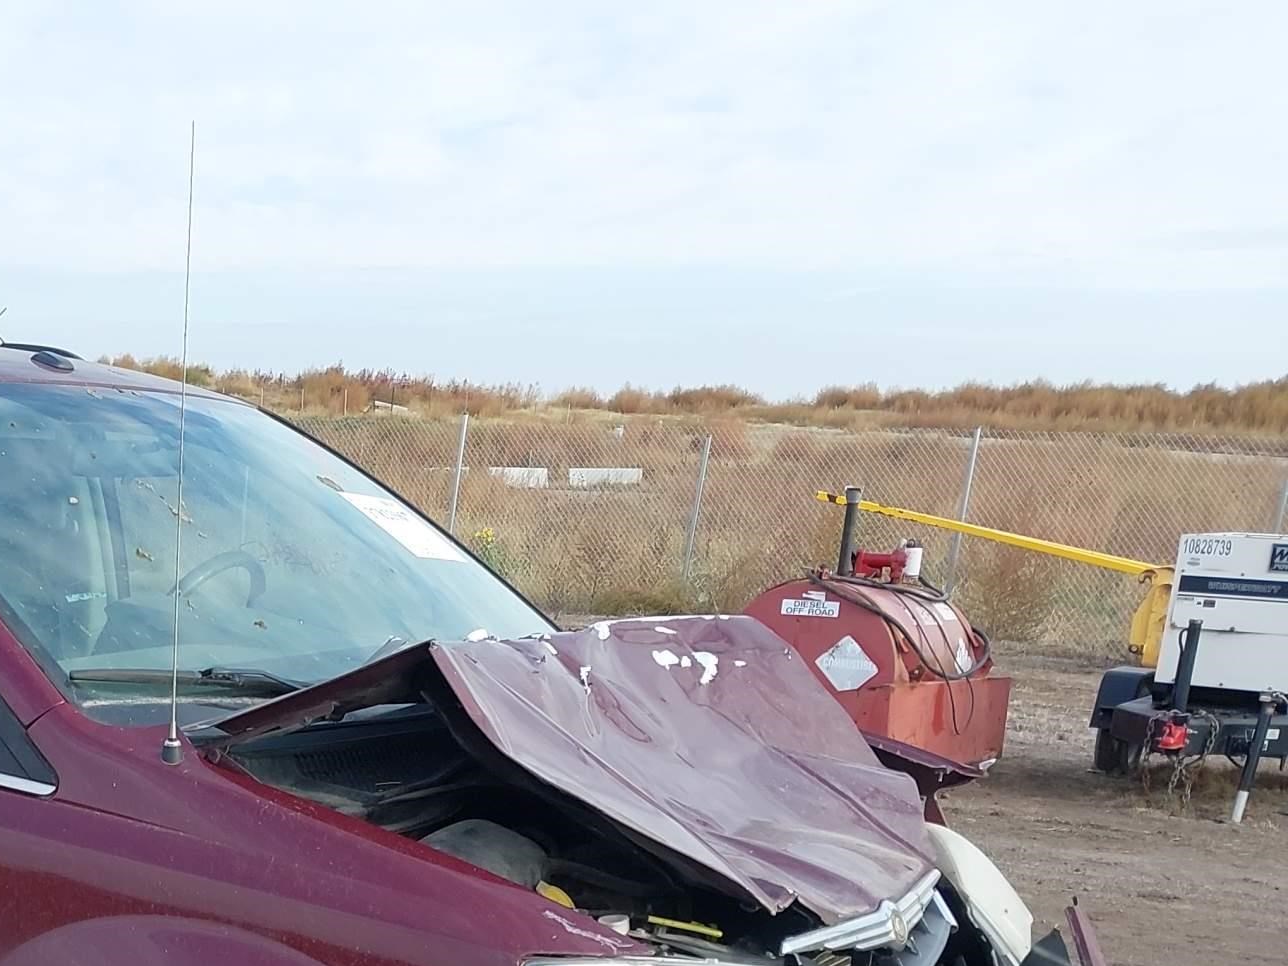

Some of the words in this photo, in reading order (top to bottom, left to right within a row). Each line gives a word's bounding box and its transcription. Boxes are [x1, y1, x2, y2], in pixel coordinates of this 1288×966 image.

[1183, 539, 1232, 556] 10828739
[794, 600, 827, 609] DIESEL
[785, 607, 804, 615] OFF
[808, 608, 835, 616] ROAD
